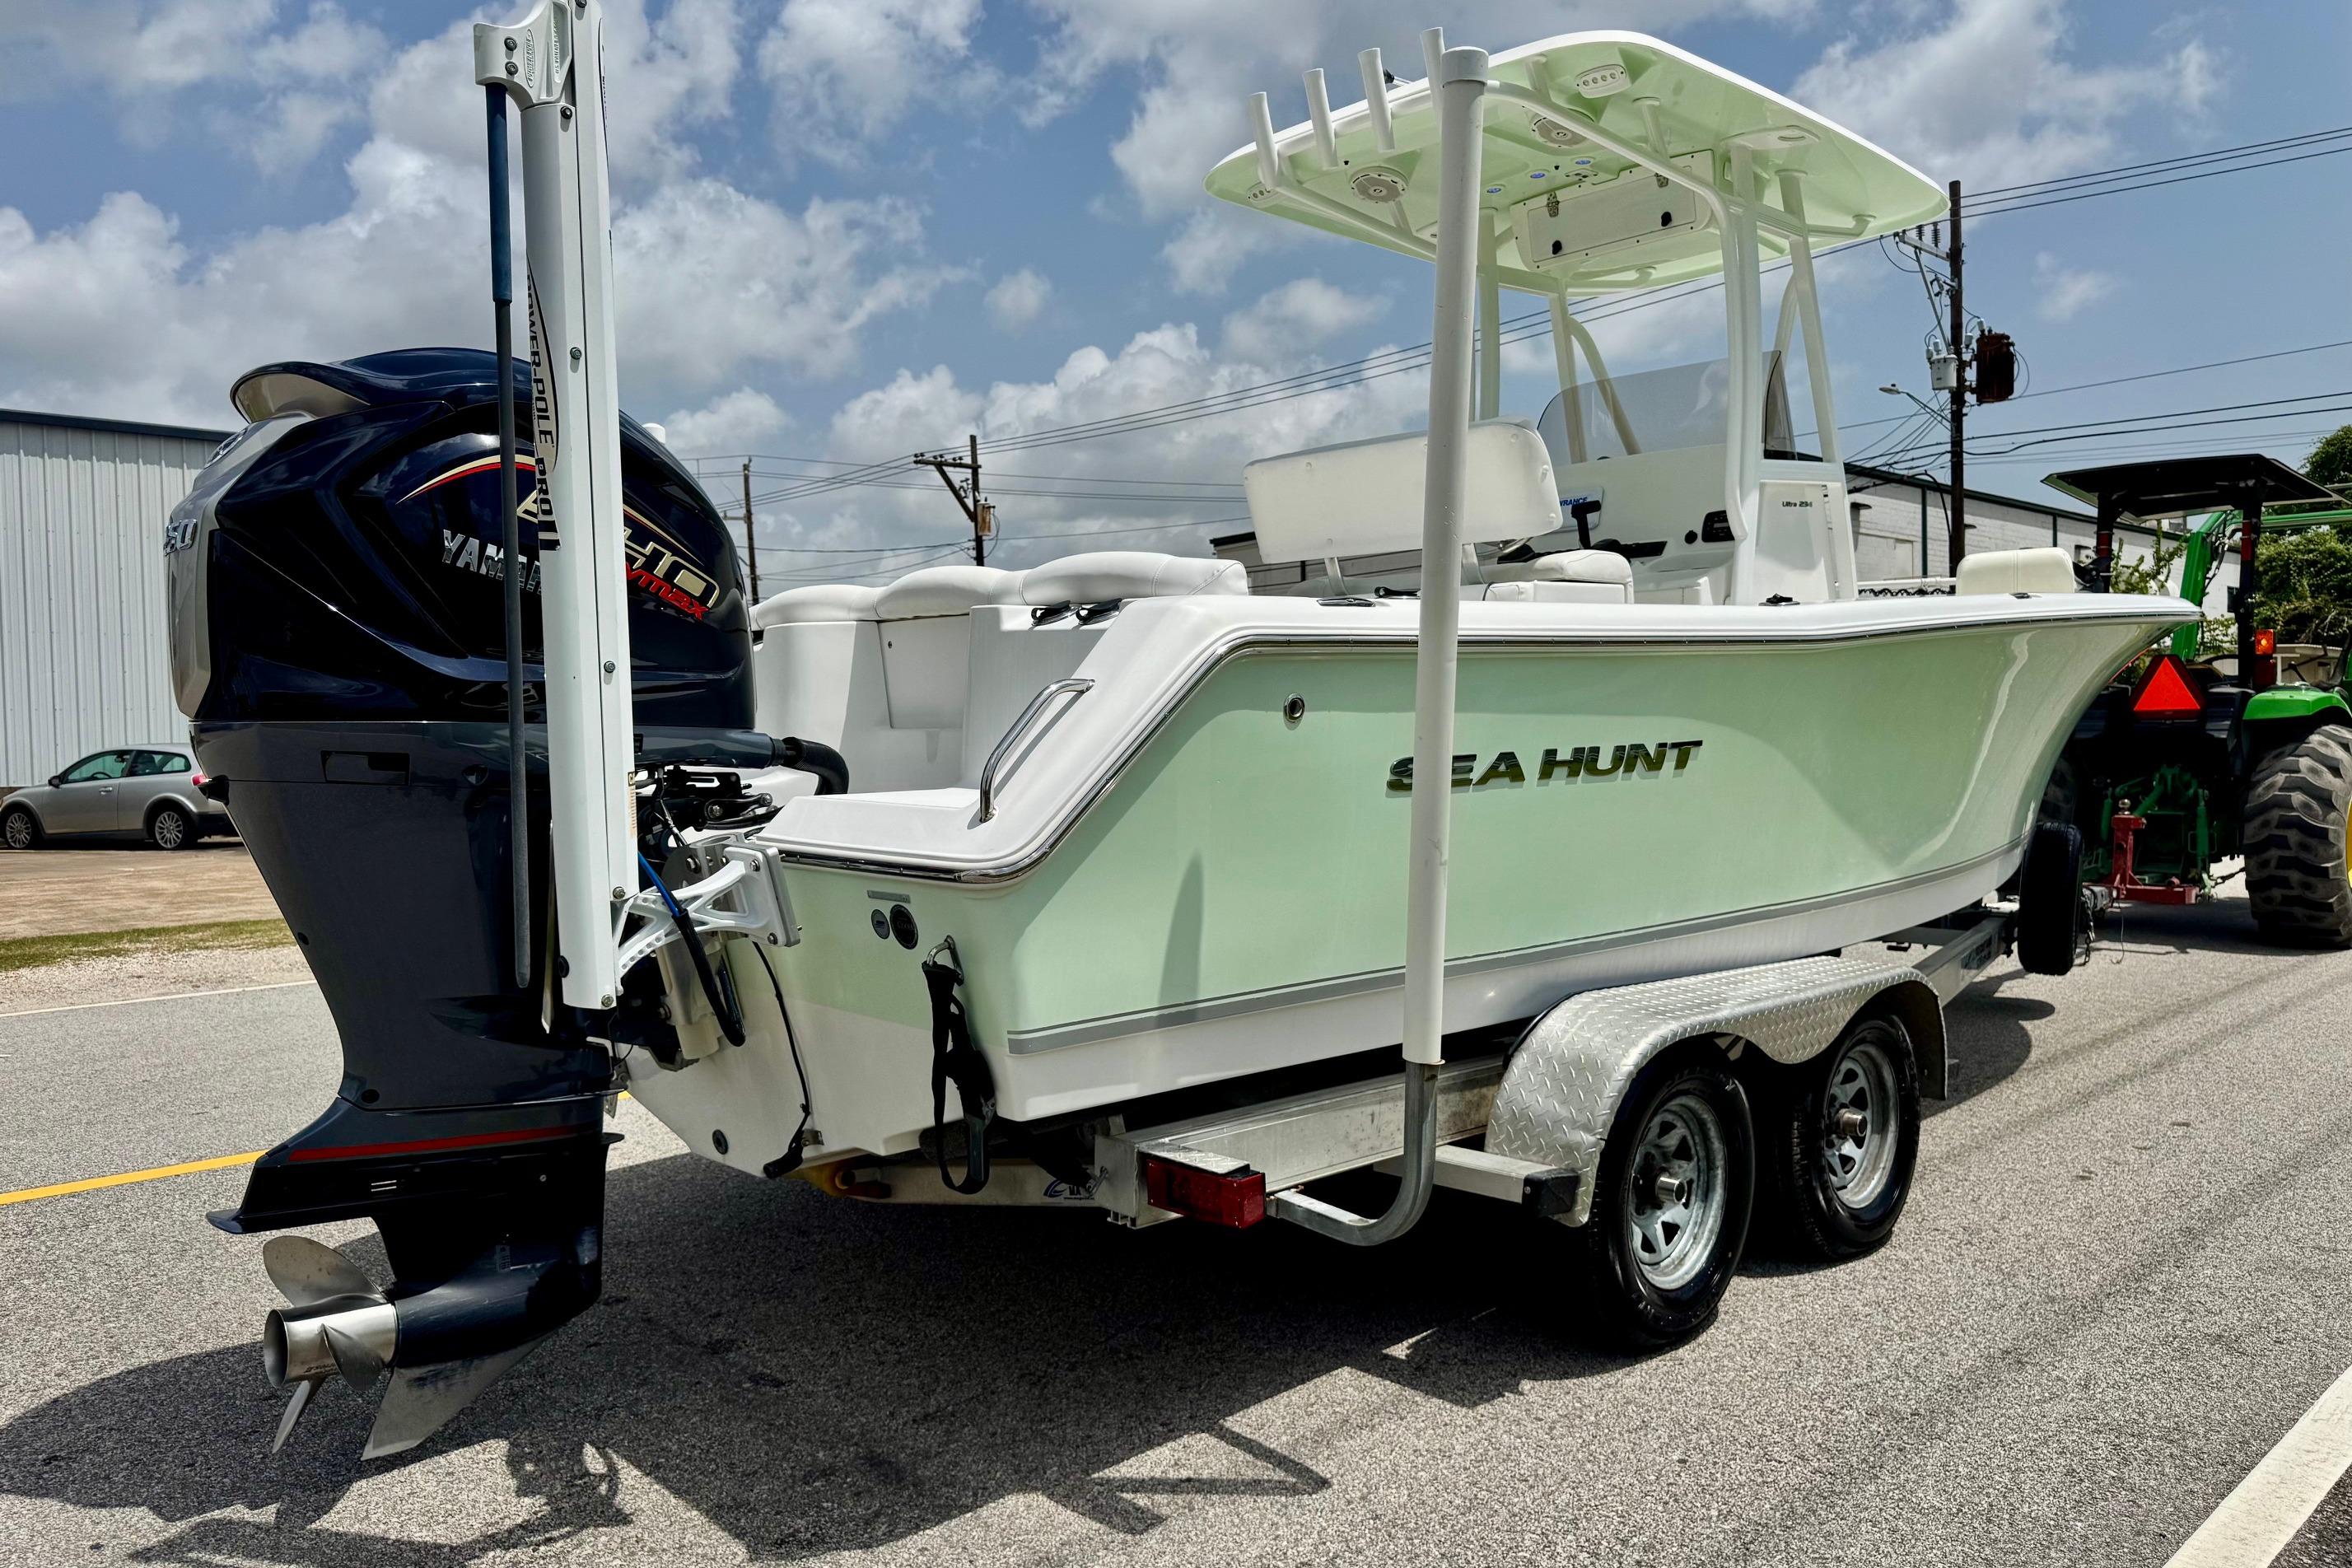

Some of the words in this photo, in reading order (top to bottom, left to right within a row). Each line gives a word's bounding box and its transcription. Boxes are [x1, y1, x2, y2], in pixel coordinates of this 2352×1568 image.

[535, 457, 553, 516] PRO
[1386, 751, 1525, 792] SEA
[1538, 740, 1704, 781] HUNT
